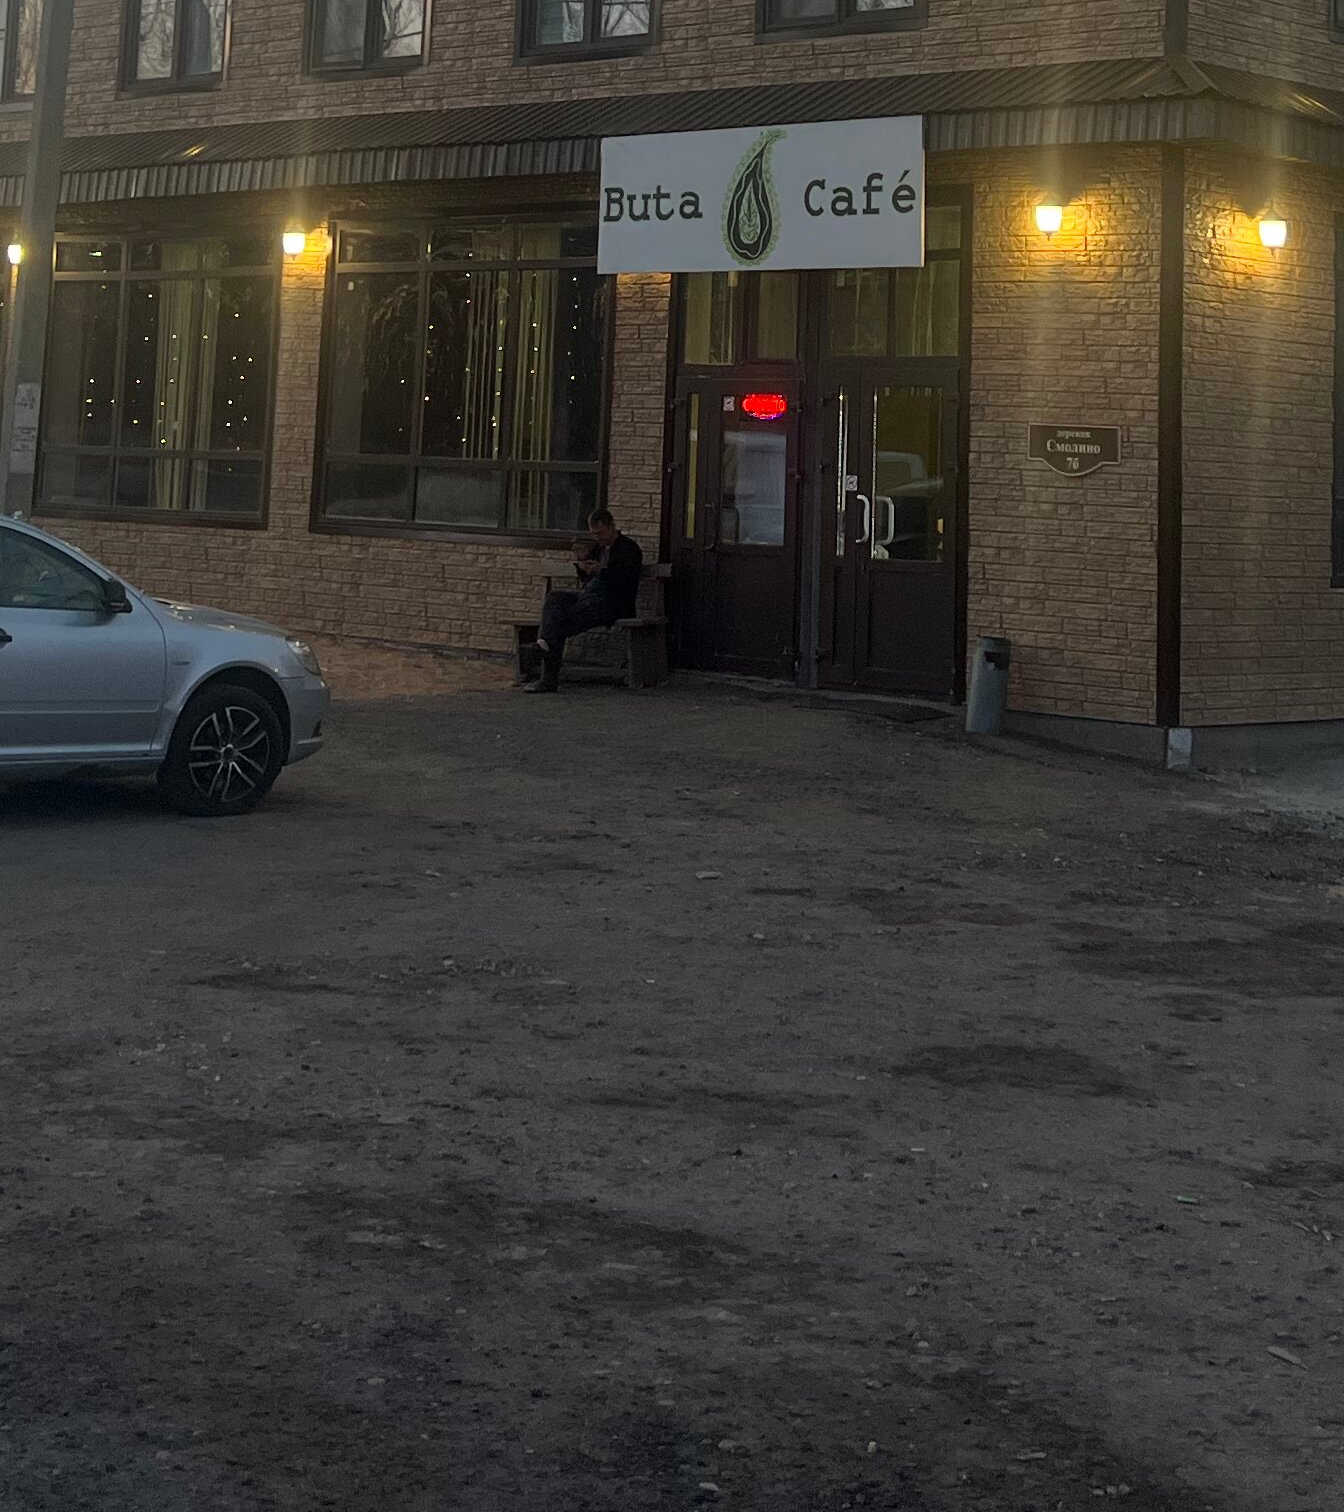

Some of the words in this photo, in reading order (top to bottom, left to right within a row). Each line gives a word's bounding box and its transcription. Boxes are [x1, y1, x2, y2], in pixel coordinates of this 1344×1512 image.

[603, 185, 704, 223] Buta
[804, 169, 916, 217] Café
[1046, 439, 1101, 455] Смолино
